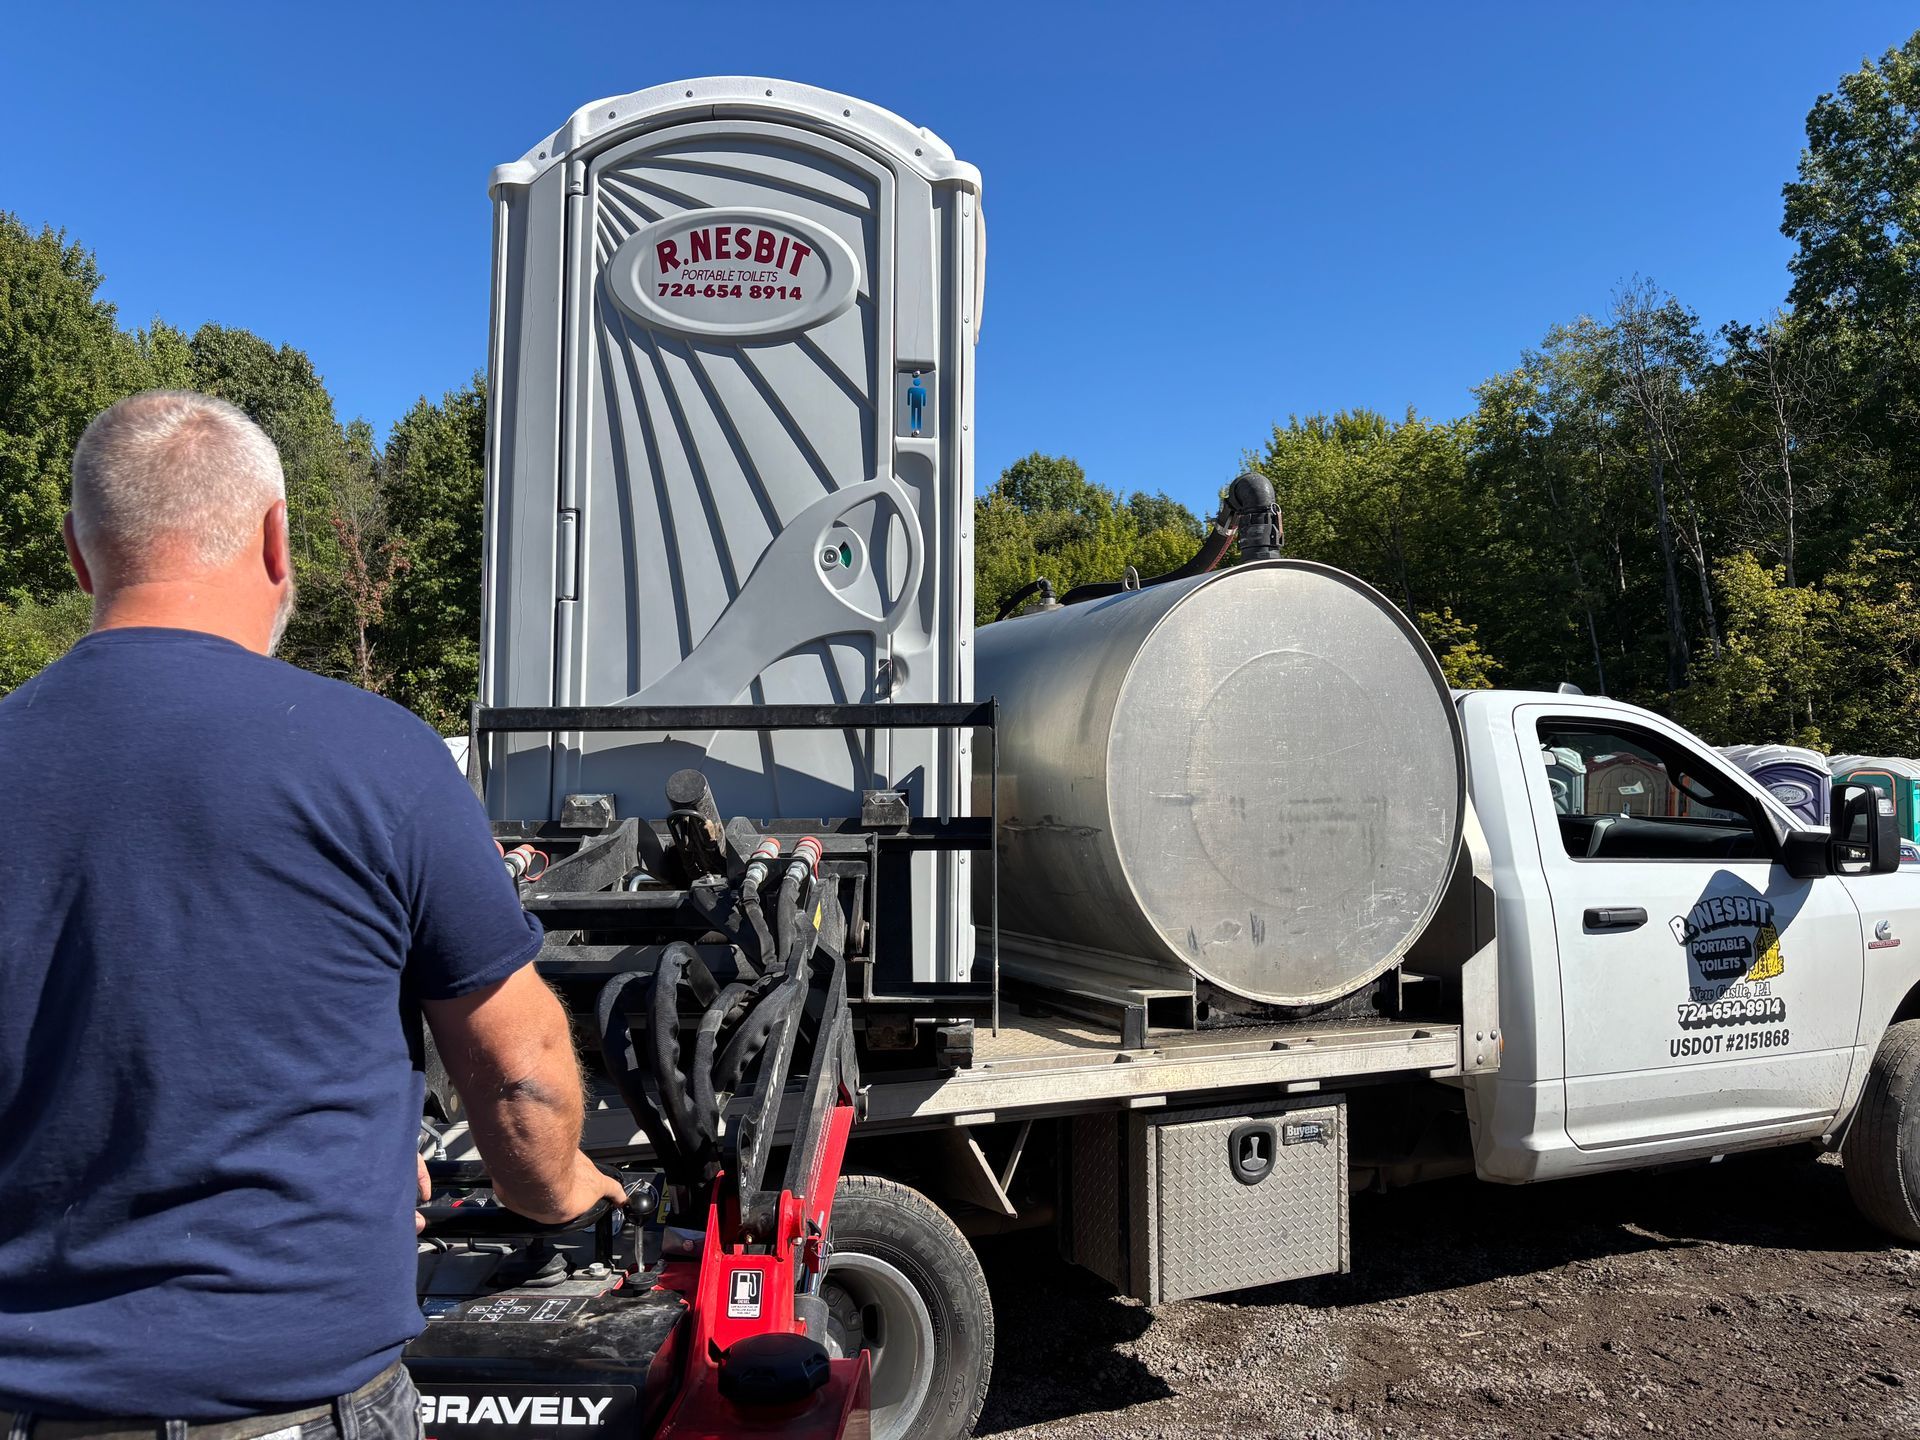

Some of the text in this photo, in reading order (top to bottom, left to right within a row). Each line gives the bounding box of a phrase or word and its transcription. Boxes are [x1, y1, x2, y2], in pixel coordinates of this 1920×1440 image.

[656, 226, 812, 277] R.NESBIT
[681, 269, 778, 282] PORTABLE TOILETS
[658, 283, 802, 300] 724-654 8914
[1692, 937, 1748, 956] PORTABLE
[1700, 957, 1742, 974] TOILETS
[1689, 987, 1714, 1002] New
[1754, 981, 1771, 996] PA
[1678, 998, 1783, 1025] 724-654-8914
[1670, 1028, 1790, 1057] USDOT #2151868
[1286, 1125, 1319, 1137] Buyers
